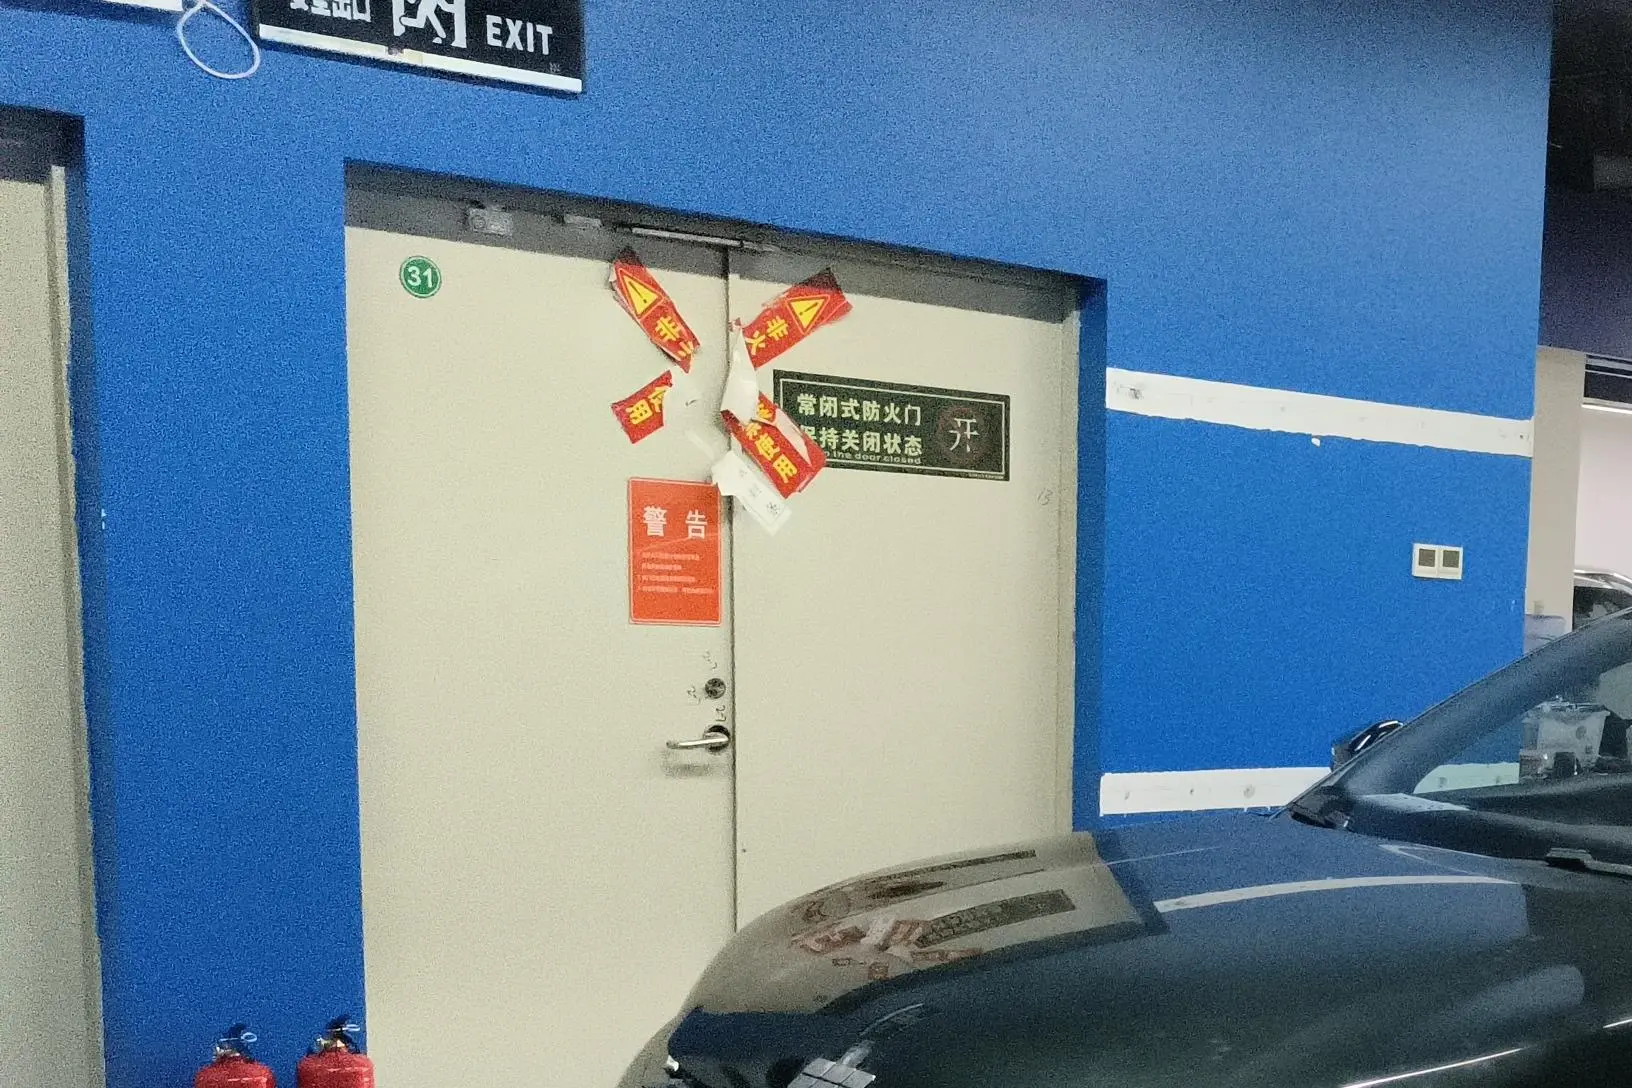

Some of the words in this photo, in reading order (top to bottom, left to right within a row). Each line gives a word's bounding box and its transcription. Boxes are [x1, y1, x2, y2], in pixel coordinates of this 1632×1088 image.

[486, 15, 553, 55] EXIT
[407, 266, 433, 288] 31
[797, 393, 922, 427] 常闭式防火门
[855, 452, 881, 462] door
[883, 455, 921, 465] closed
[643, 505, 708, 539] 警告
